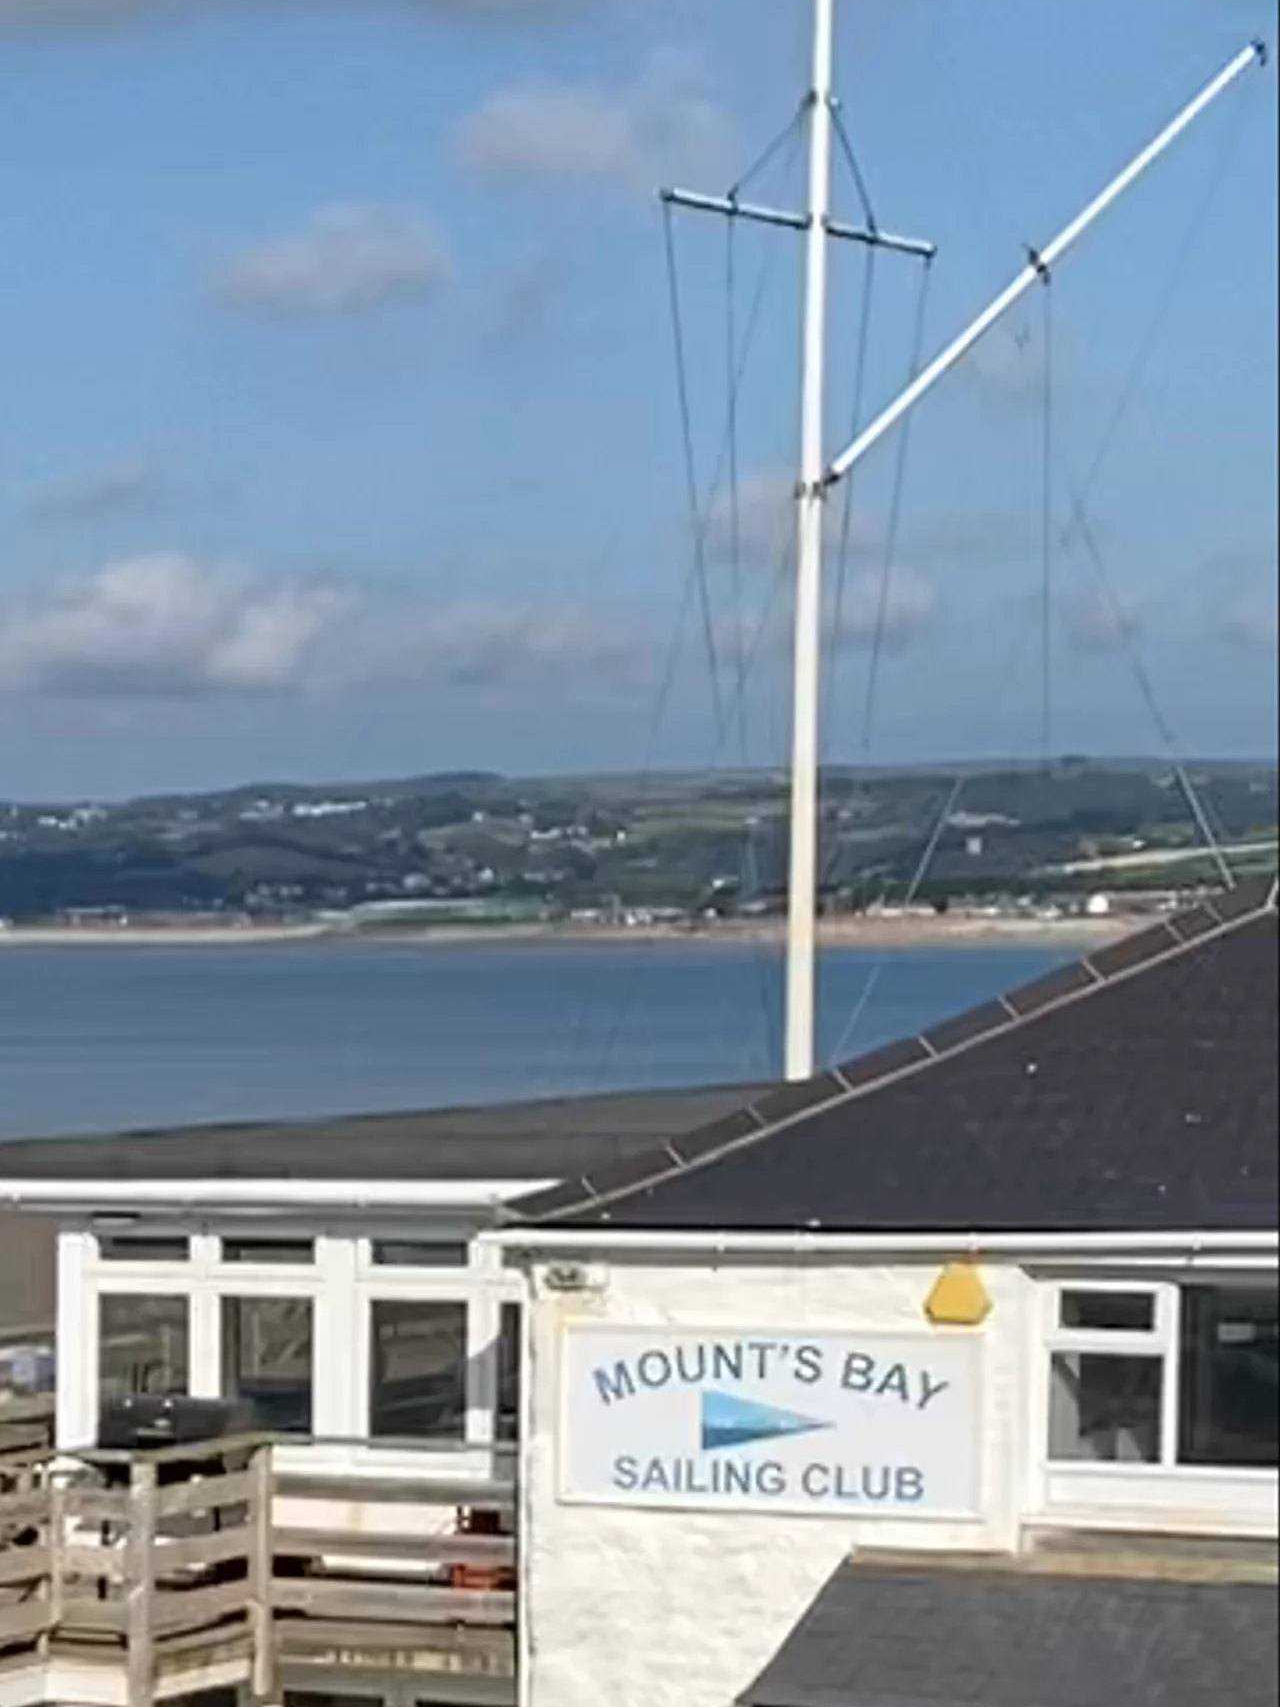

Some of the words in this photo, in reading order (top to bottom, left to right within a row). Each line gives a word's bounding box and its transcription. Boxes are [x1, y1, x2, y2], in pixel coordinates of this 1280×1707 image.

[591, 1341, 825, 1407] MOUNT'S
[839, 1350, 950, 1412] BAY
[611, 1454, 788, 1495] SAILING
[800, 1461, 926, 1502] CLUB
